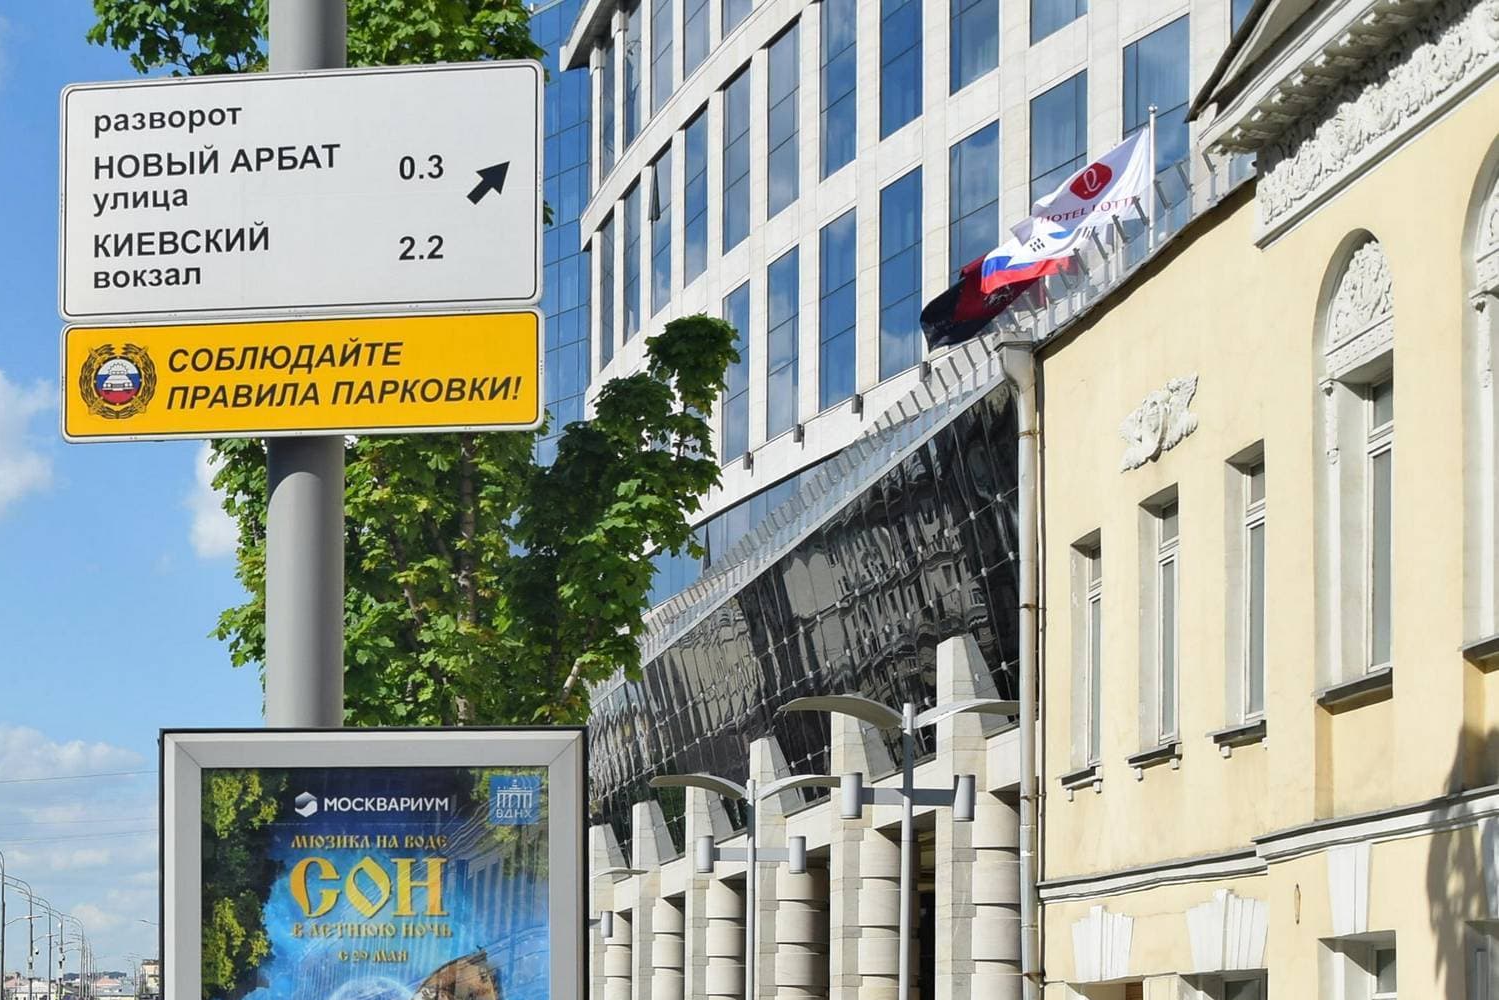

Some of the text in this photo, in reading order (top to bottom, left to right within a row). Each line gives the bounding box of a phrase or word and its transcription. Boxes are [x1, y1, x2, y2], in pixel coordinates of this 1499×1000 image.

[93, 105, 243, 138] разворот
[93, 143, 445, 181] НОВЫЙ АРБАТ 0.3
[92, 185, 189, 217] улица
[93, 221, 445, 261] КИЕВСКИЙ 2.2
[93, 264, 202, 290] вокзал
[167, 338, 403, 375] СОБЛЮДАЙТЕ
[166, 375, 523, 411] ПРАВИЛА ПАРКОВКИ!
[323, 796, 449, 813] МОСКВАРИУМ
[496, 808, 533, 819] ВДНХ
[291, 834, 448, 850] МЮЗИКЛ НА ВОДЕ
[289, 855, 450, 919] СОН
[293, 922, 454, 939] В ЛЕТНЮЮ НОЧЬ
